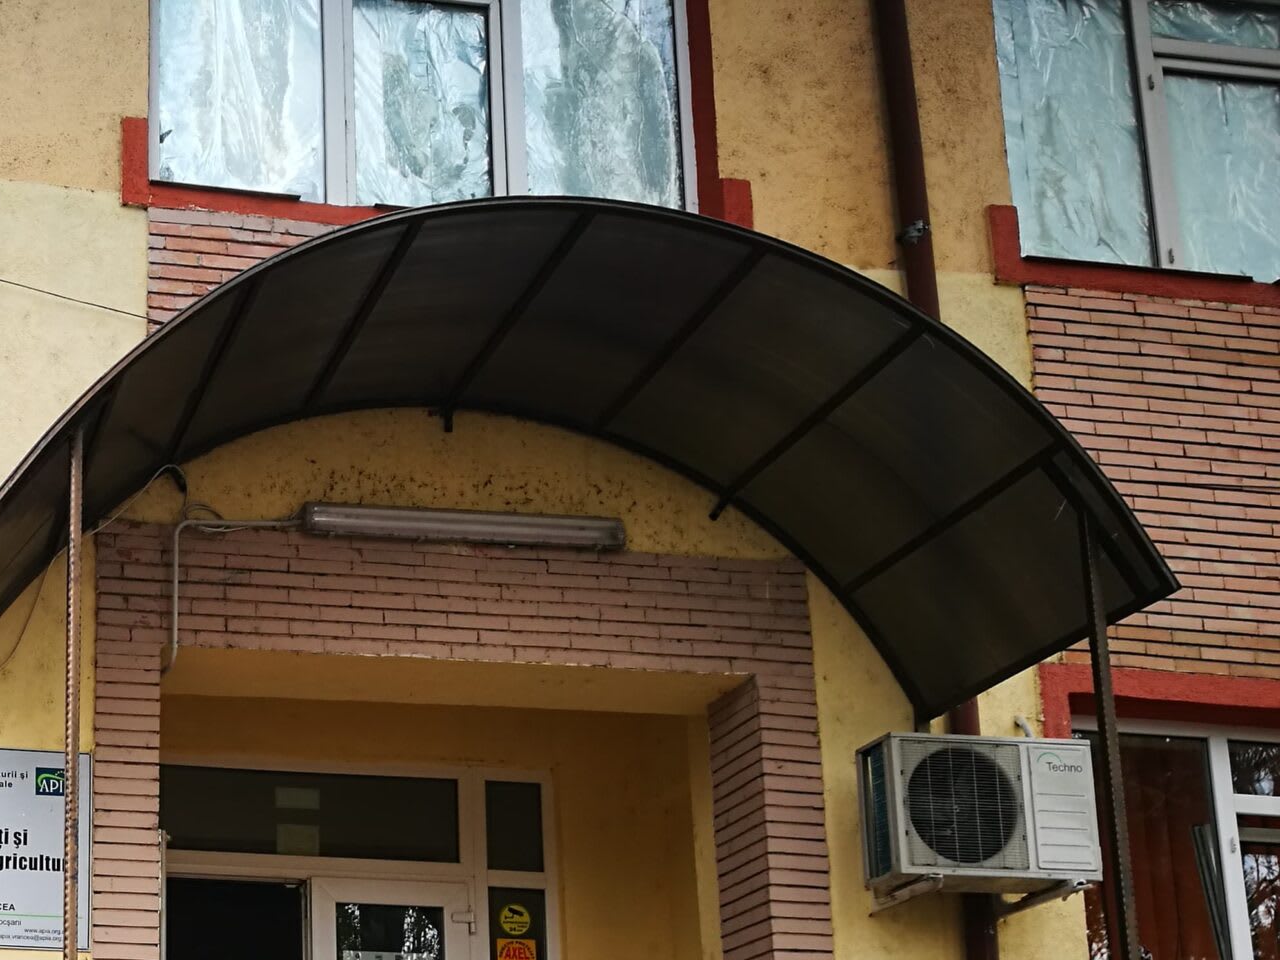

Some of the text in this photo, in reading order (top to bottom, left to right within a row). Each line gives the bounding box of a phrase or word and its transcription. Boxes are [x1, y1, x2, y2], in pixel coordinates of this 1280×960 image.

[1046, 762, 1082, 772] Techno
[39, 779, 64, 793] API
[504, 947, 530, 960] AXEL
